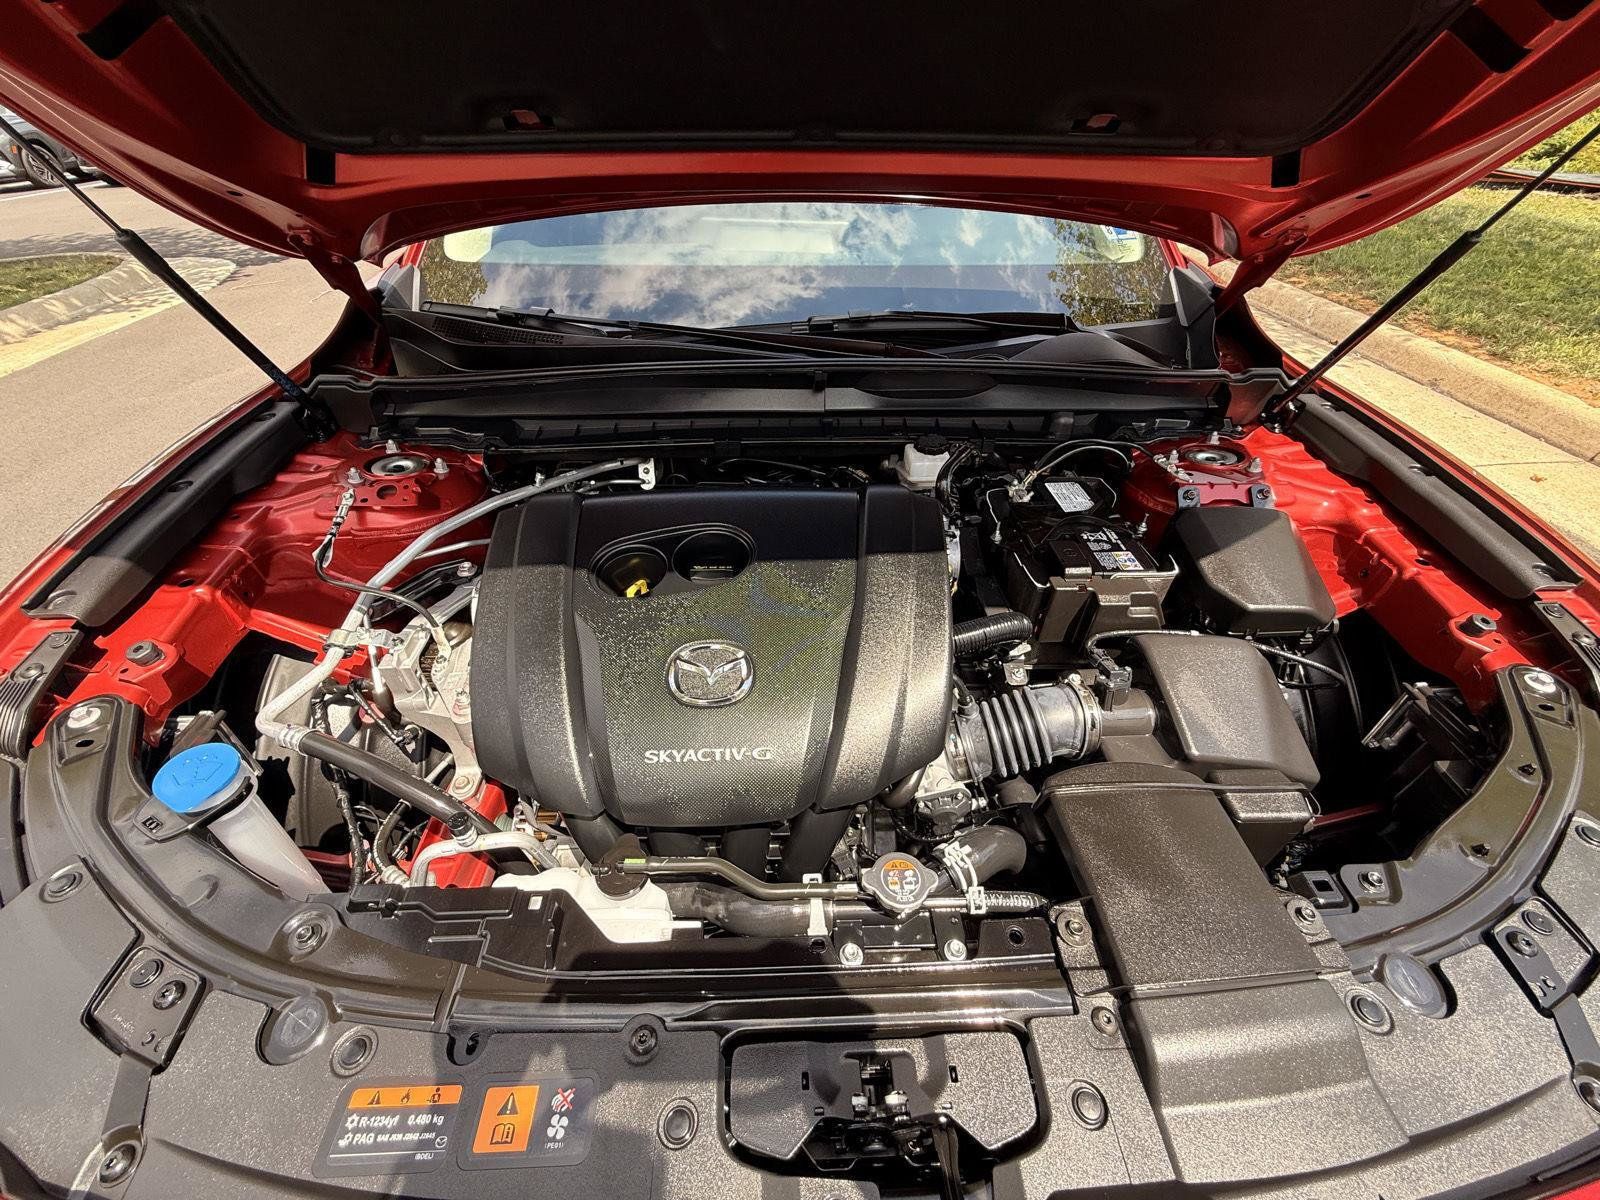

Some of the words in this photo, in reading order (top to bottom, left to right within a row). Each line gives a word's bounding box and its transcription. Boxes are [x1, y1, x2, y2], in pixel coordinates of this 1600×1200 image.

[644, 747, 773, 764] SKYACTIV-G
[407, 1114, 431, 1126] 0.480
[432, 1113, 445, 1126] kg
[352, 1133, 375, 1145] PAG
